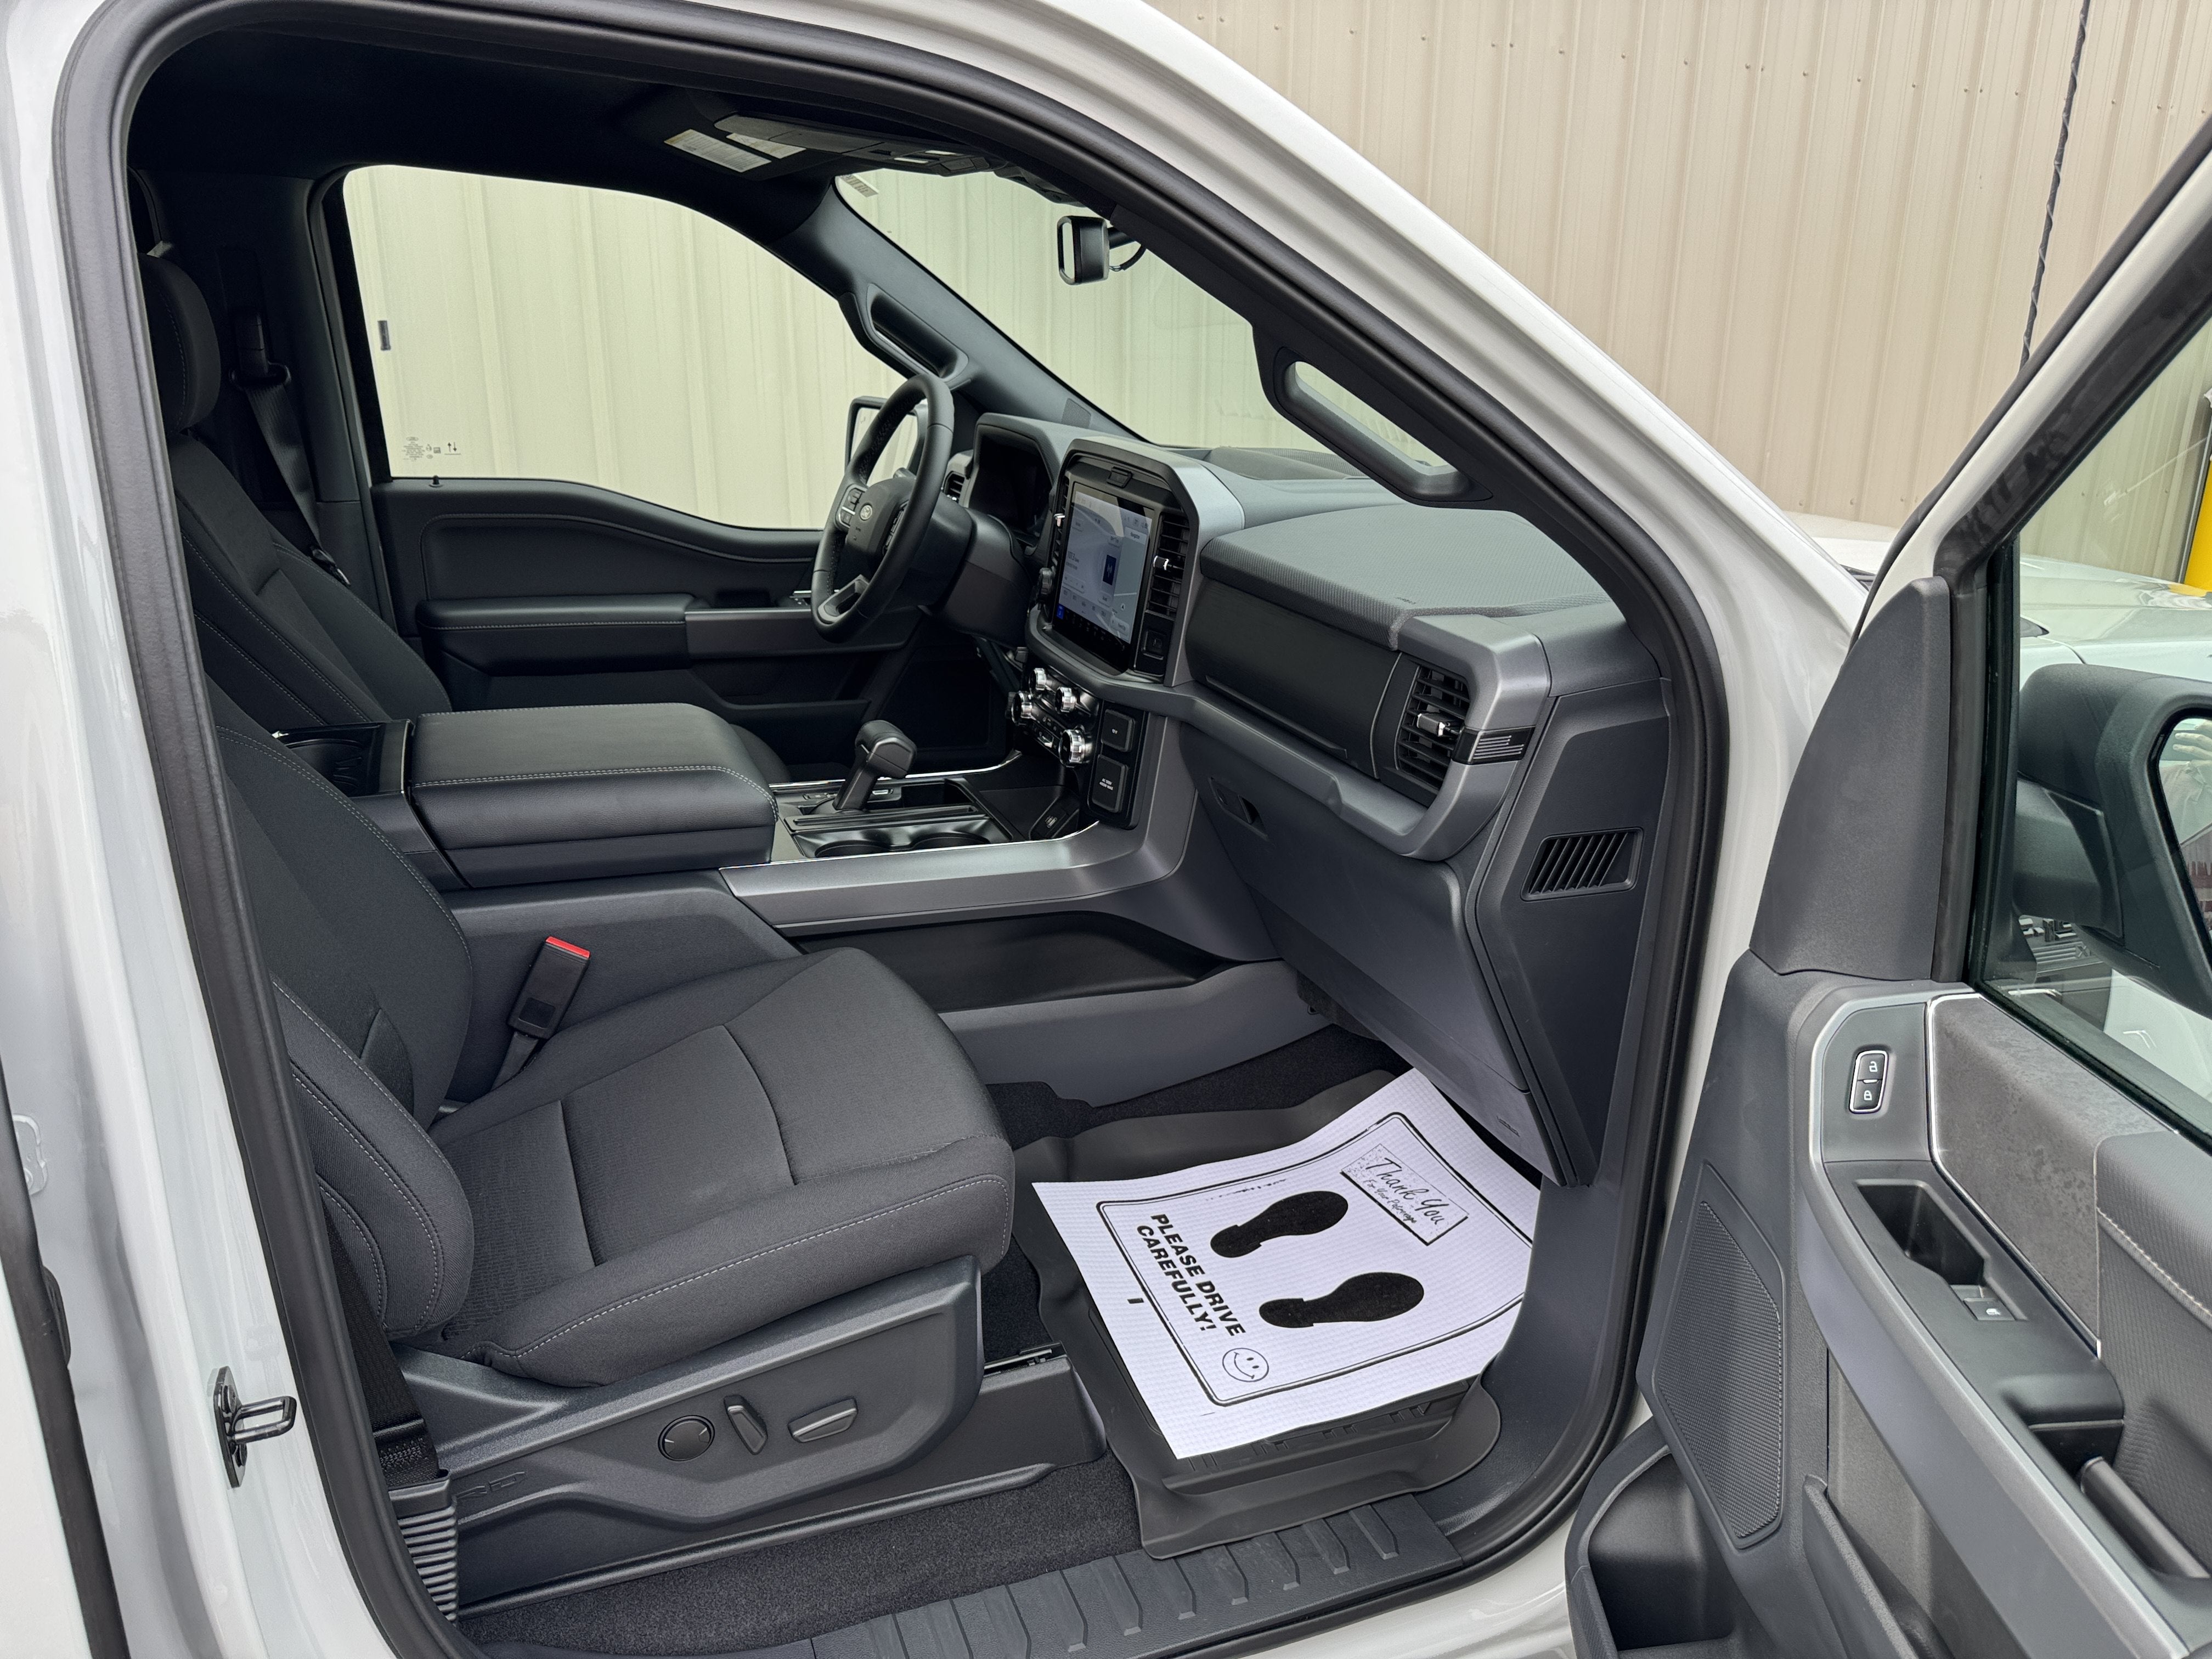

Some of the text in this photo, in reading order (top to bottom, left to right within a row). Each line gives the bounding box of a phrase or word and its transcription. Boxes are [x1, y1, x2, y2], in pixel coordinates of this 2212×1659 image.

[1365, 1157, 1449, 1225] Thank You
[1137, 1225, 1217, 1331] CAREFULLY!
[1150, 1214, 1246, 1336] PLEASE DRIVE
